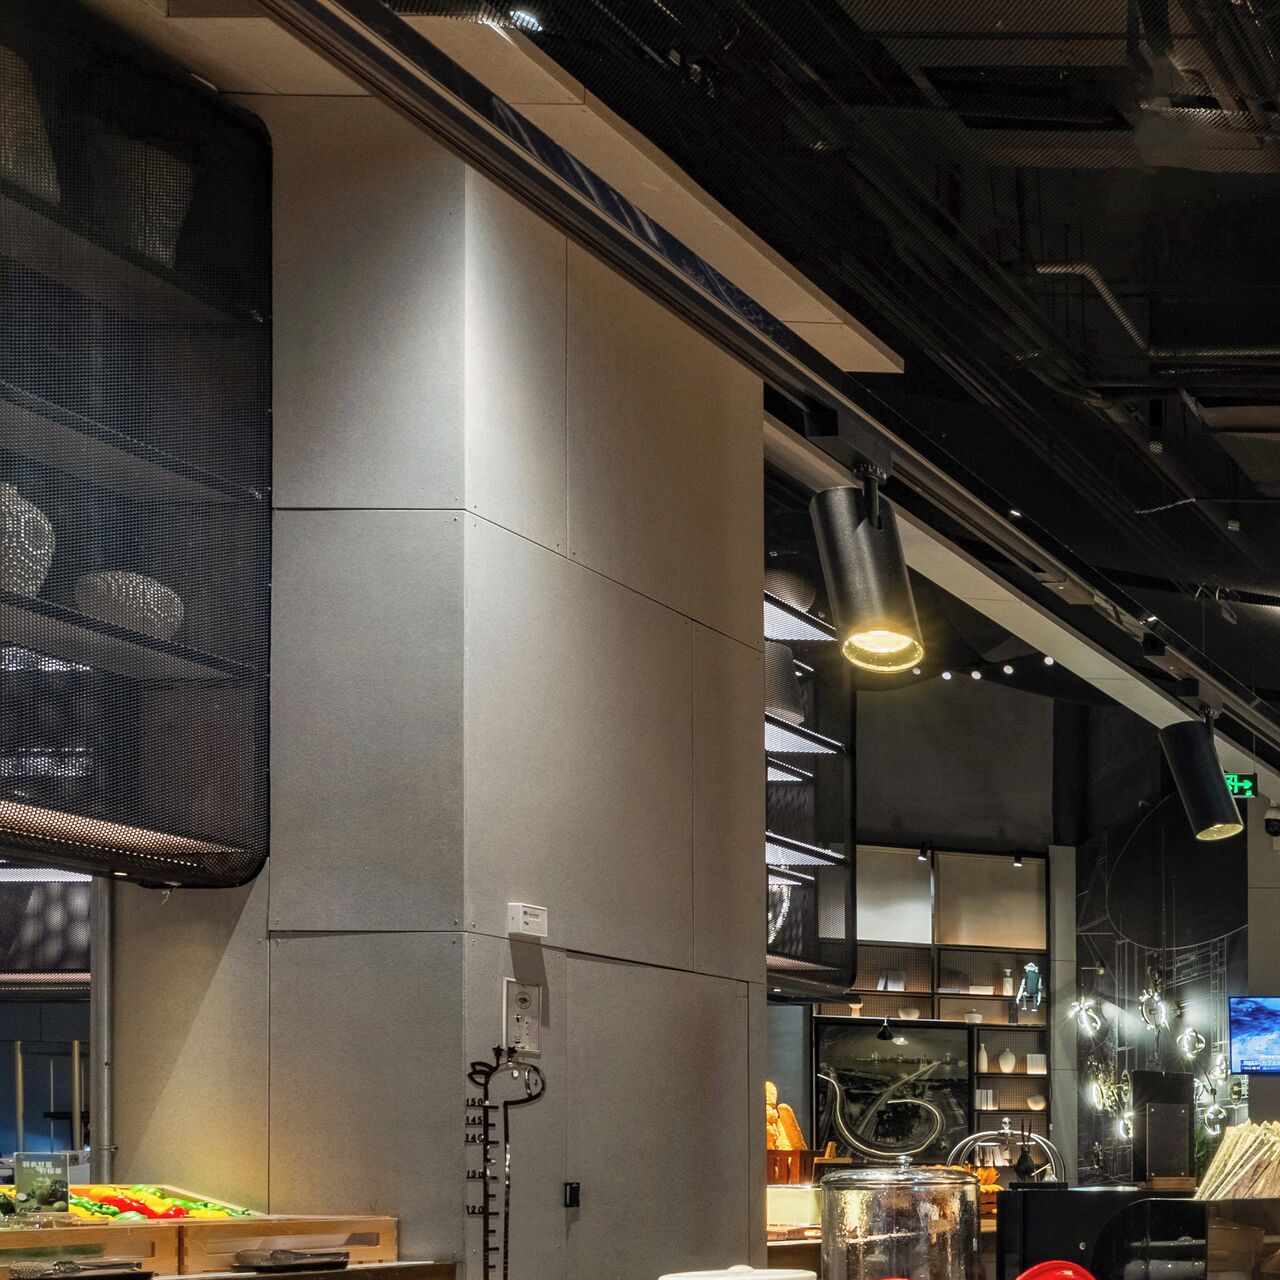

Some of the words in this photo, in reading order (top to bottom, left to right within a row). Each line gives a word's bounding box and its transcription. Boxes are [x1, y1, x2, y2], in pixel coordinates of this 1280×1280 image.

[466, 1098, 485, 1107] 150
[466, 1116, 483, 1125] 145
[467, 1206, 485, 1214] 120
